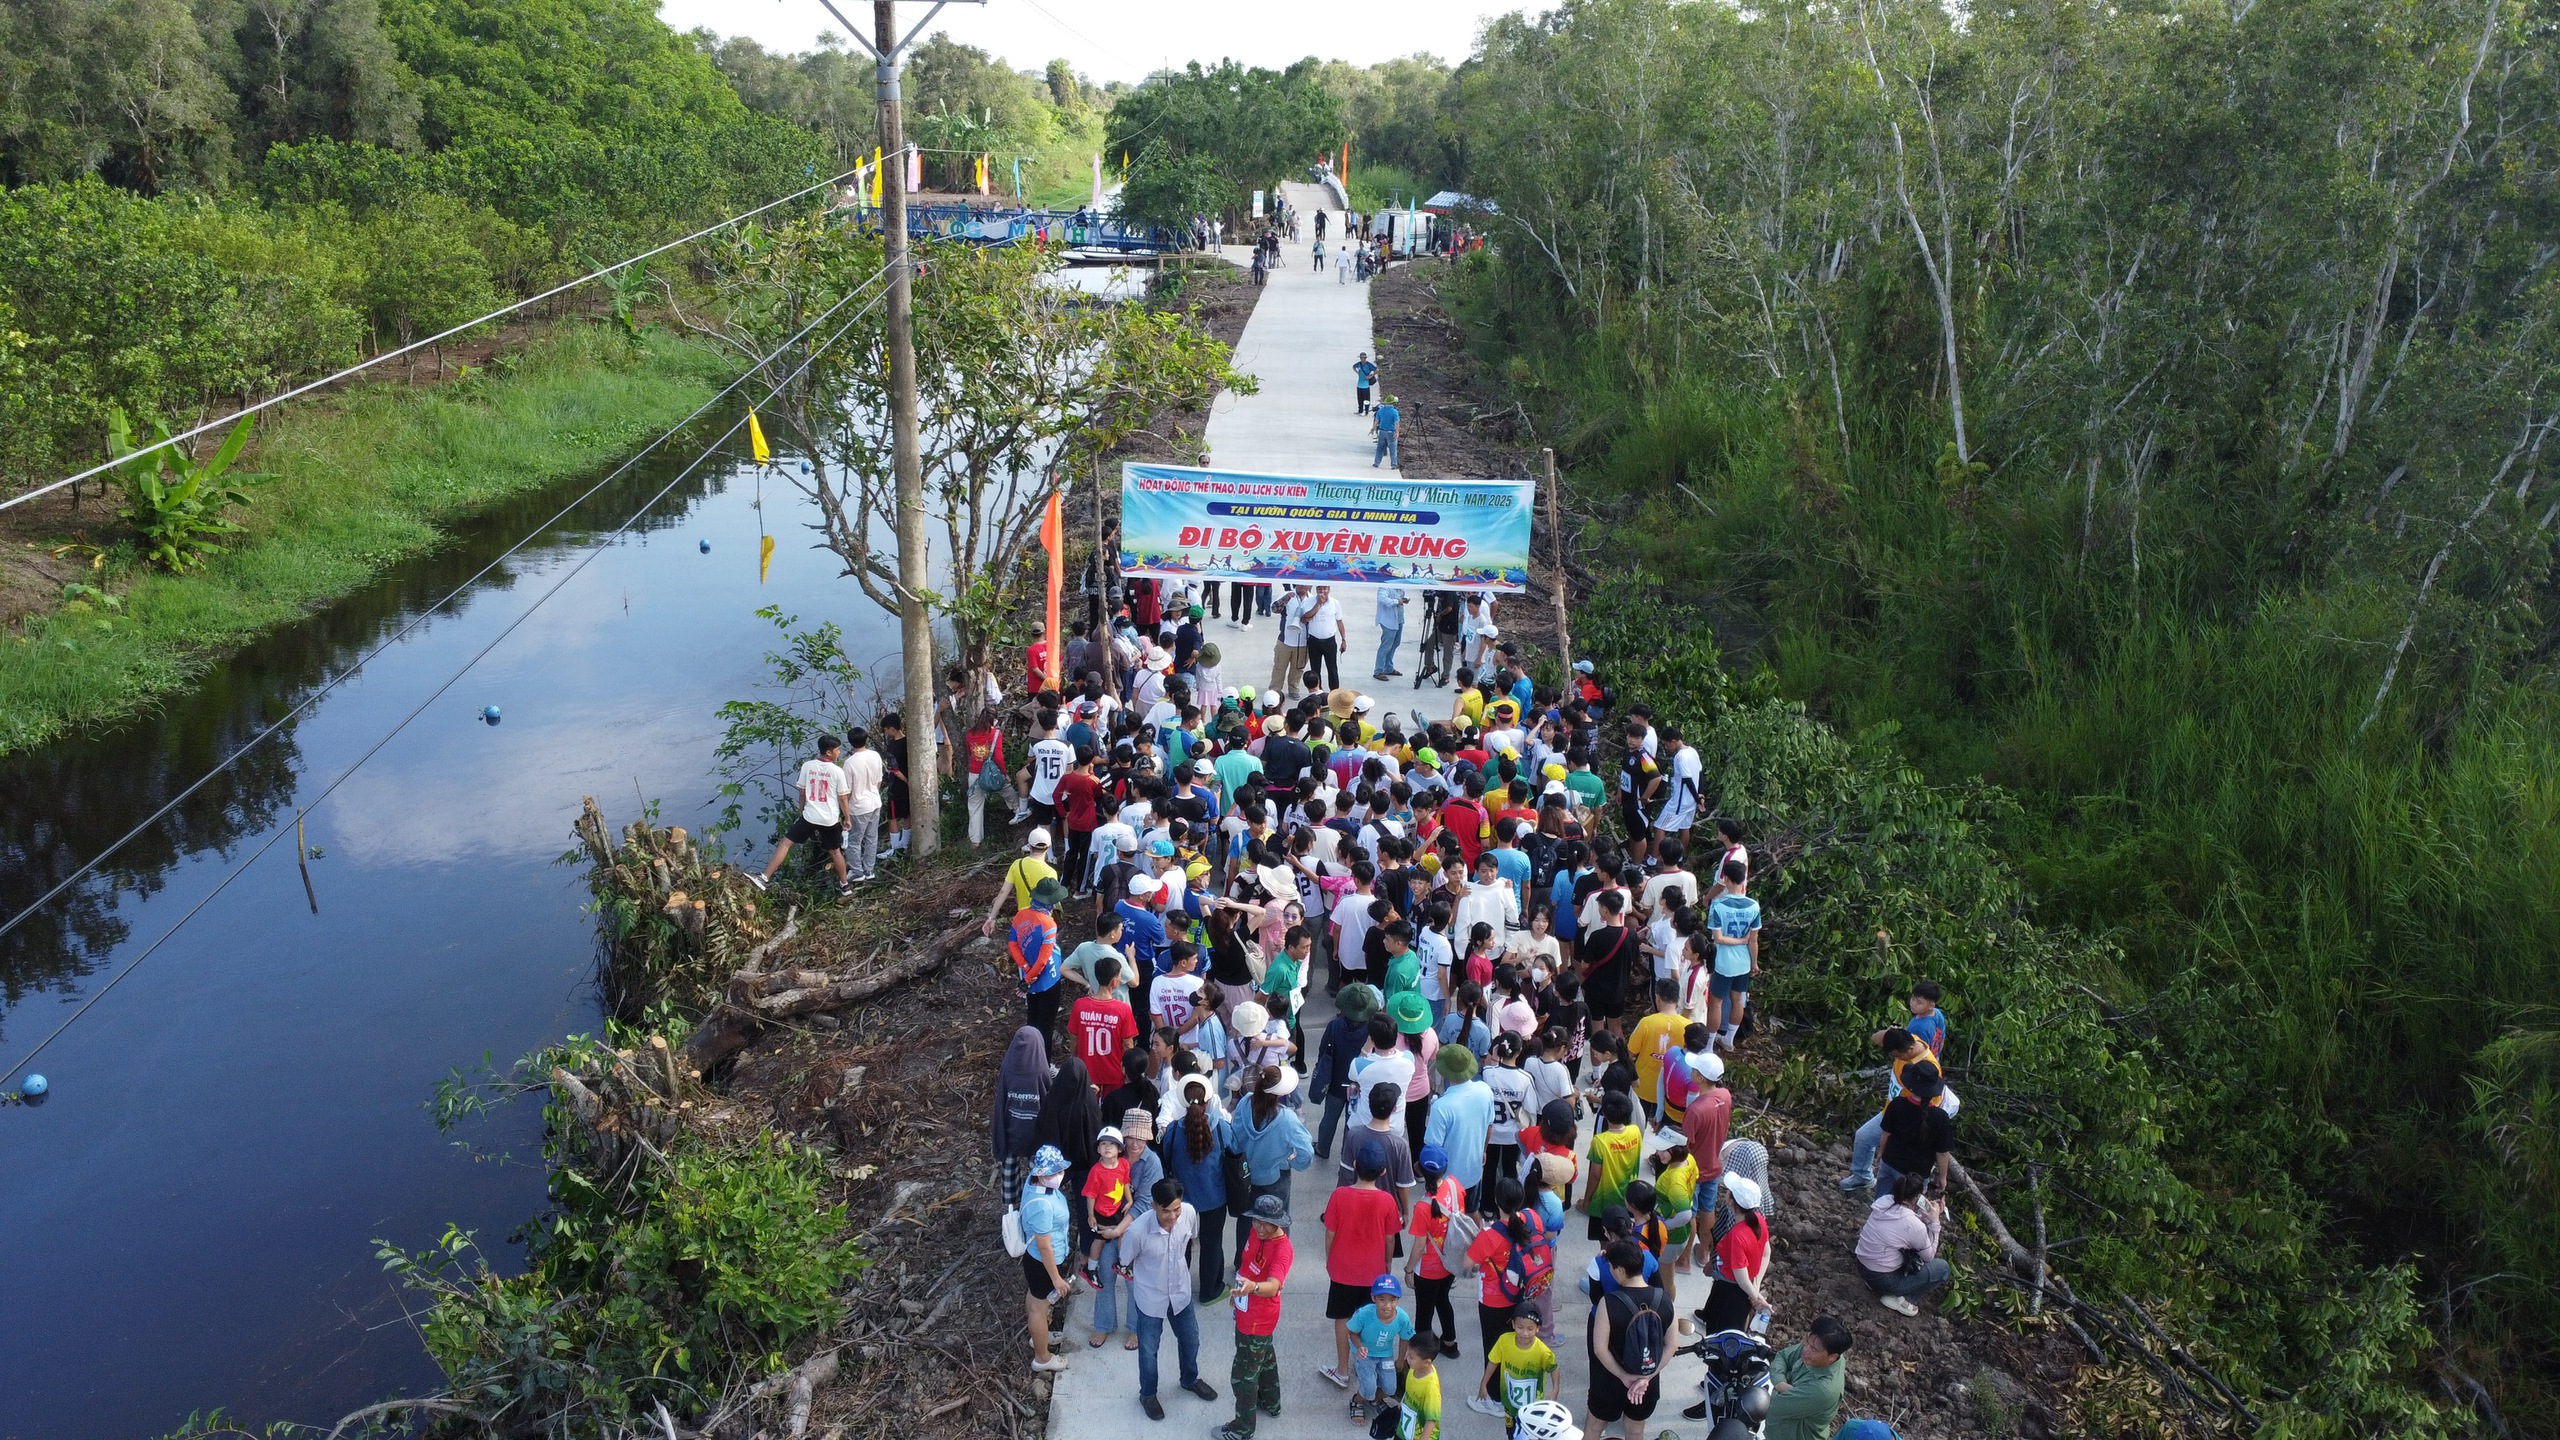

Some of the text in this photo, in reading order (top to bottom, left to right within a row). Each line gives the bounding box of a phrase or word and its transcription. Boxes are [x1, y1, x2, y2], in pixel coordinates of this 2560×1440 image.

[1139, 476, 1512, 507] HOẠT ĐỘNG THỂ THAO, DU LỊCH SỰ KIỆN Hương Rừng U Minh NĂM 2025
[1230, 505, 1417, 523] TẠI VƯỜN QUỐC GIA U MINH HẠ
[1179, 523, 1467, 558] ĐI BỘ XUYÊN RỪNG
[1041, 756, 1061, 780] 15
[809, 778, 828, 802] 10
[1080, 1011, 1102, 1022] QUÁN
[1103, 1014, 1119, 1025] 999
[1164, 1004, 1187, 1027] 12
[1086, 1026, 1112, 1056] 10
